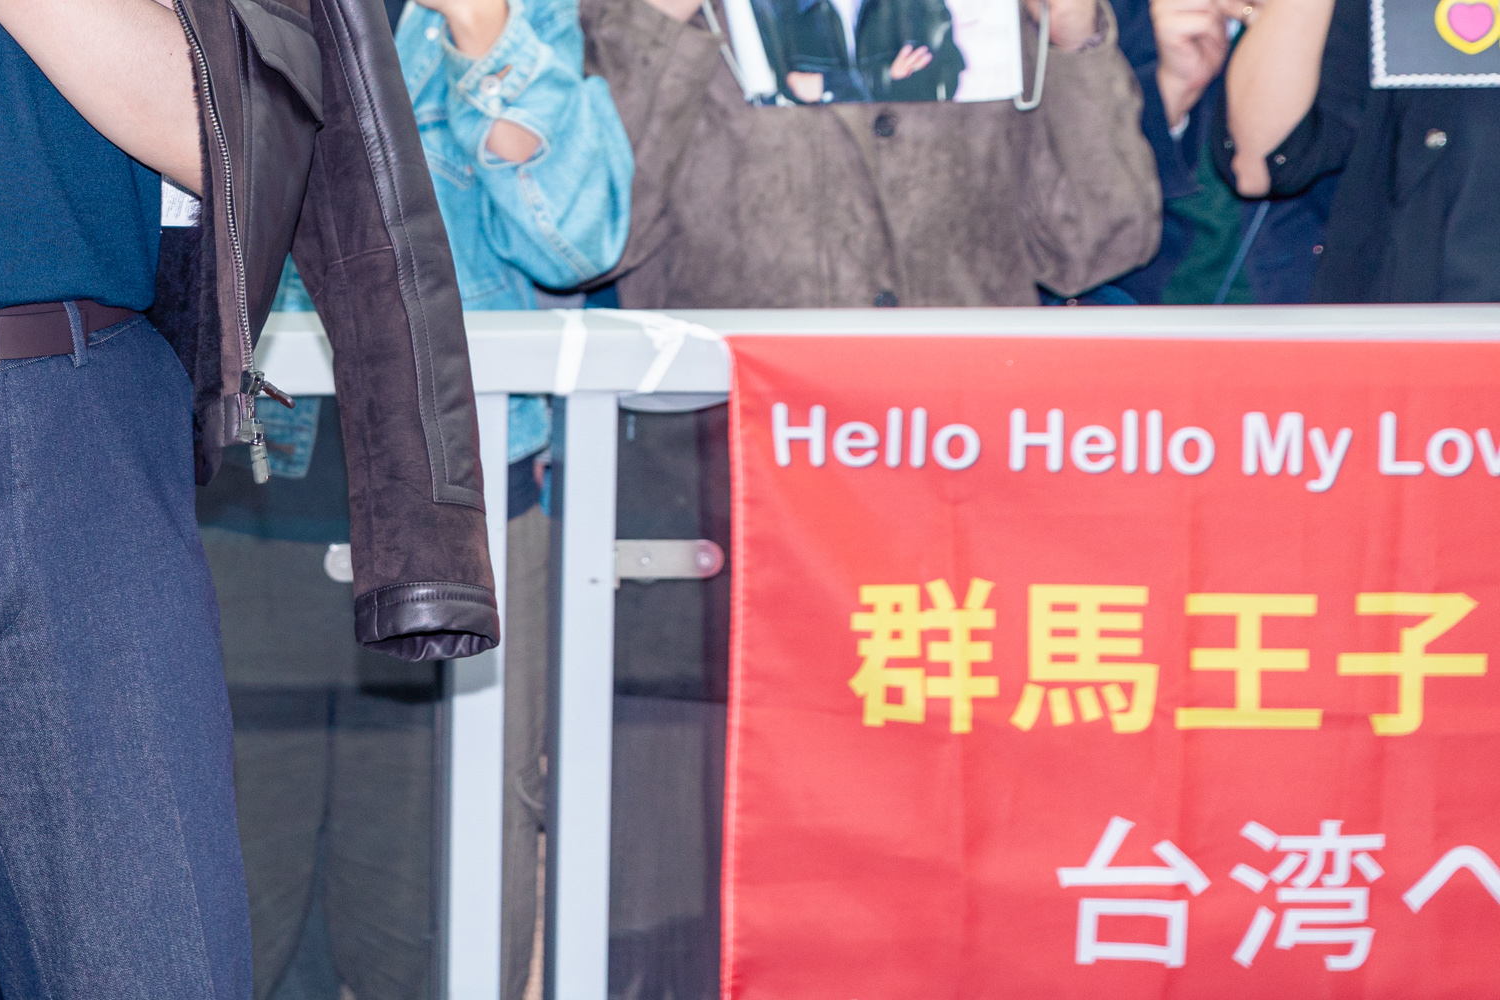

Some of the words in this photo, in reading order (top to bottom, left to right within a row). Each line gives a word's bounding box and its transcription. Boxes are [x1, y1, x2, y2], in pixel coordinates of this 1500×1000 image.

[771, 402, 981, 471] Hello
[1008, 408, 1217, 476] Hello
[1242, 411, 1353, 492] My
[848, 577, 1489, 737] 群馬王子
[1056, 816, 1500, 972] 台湾へ
